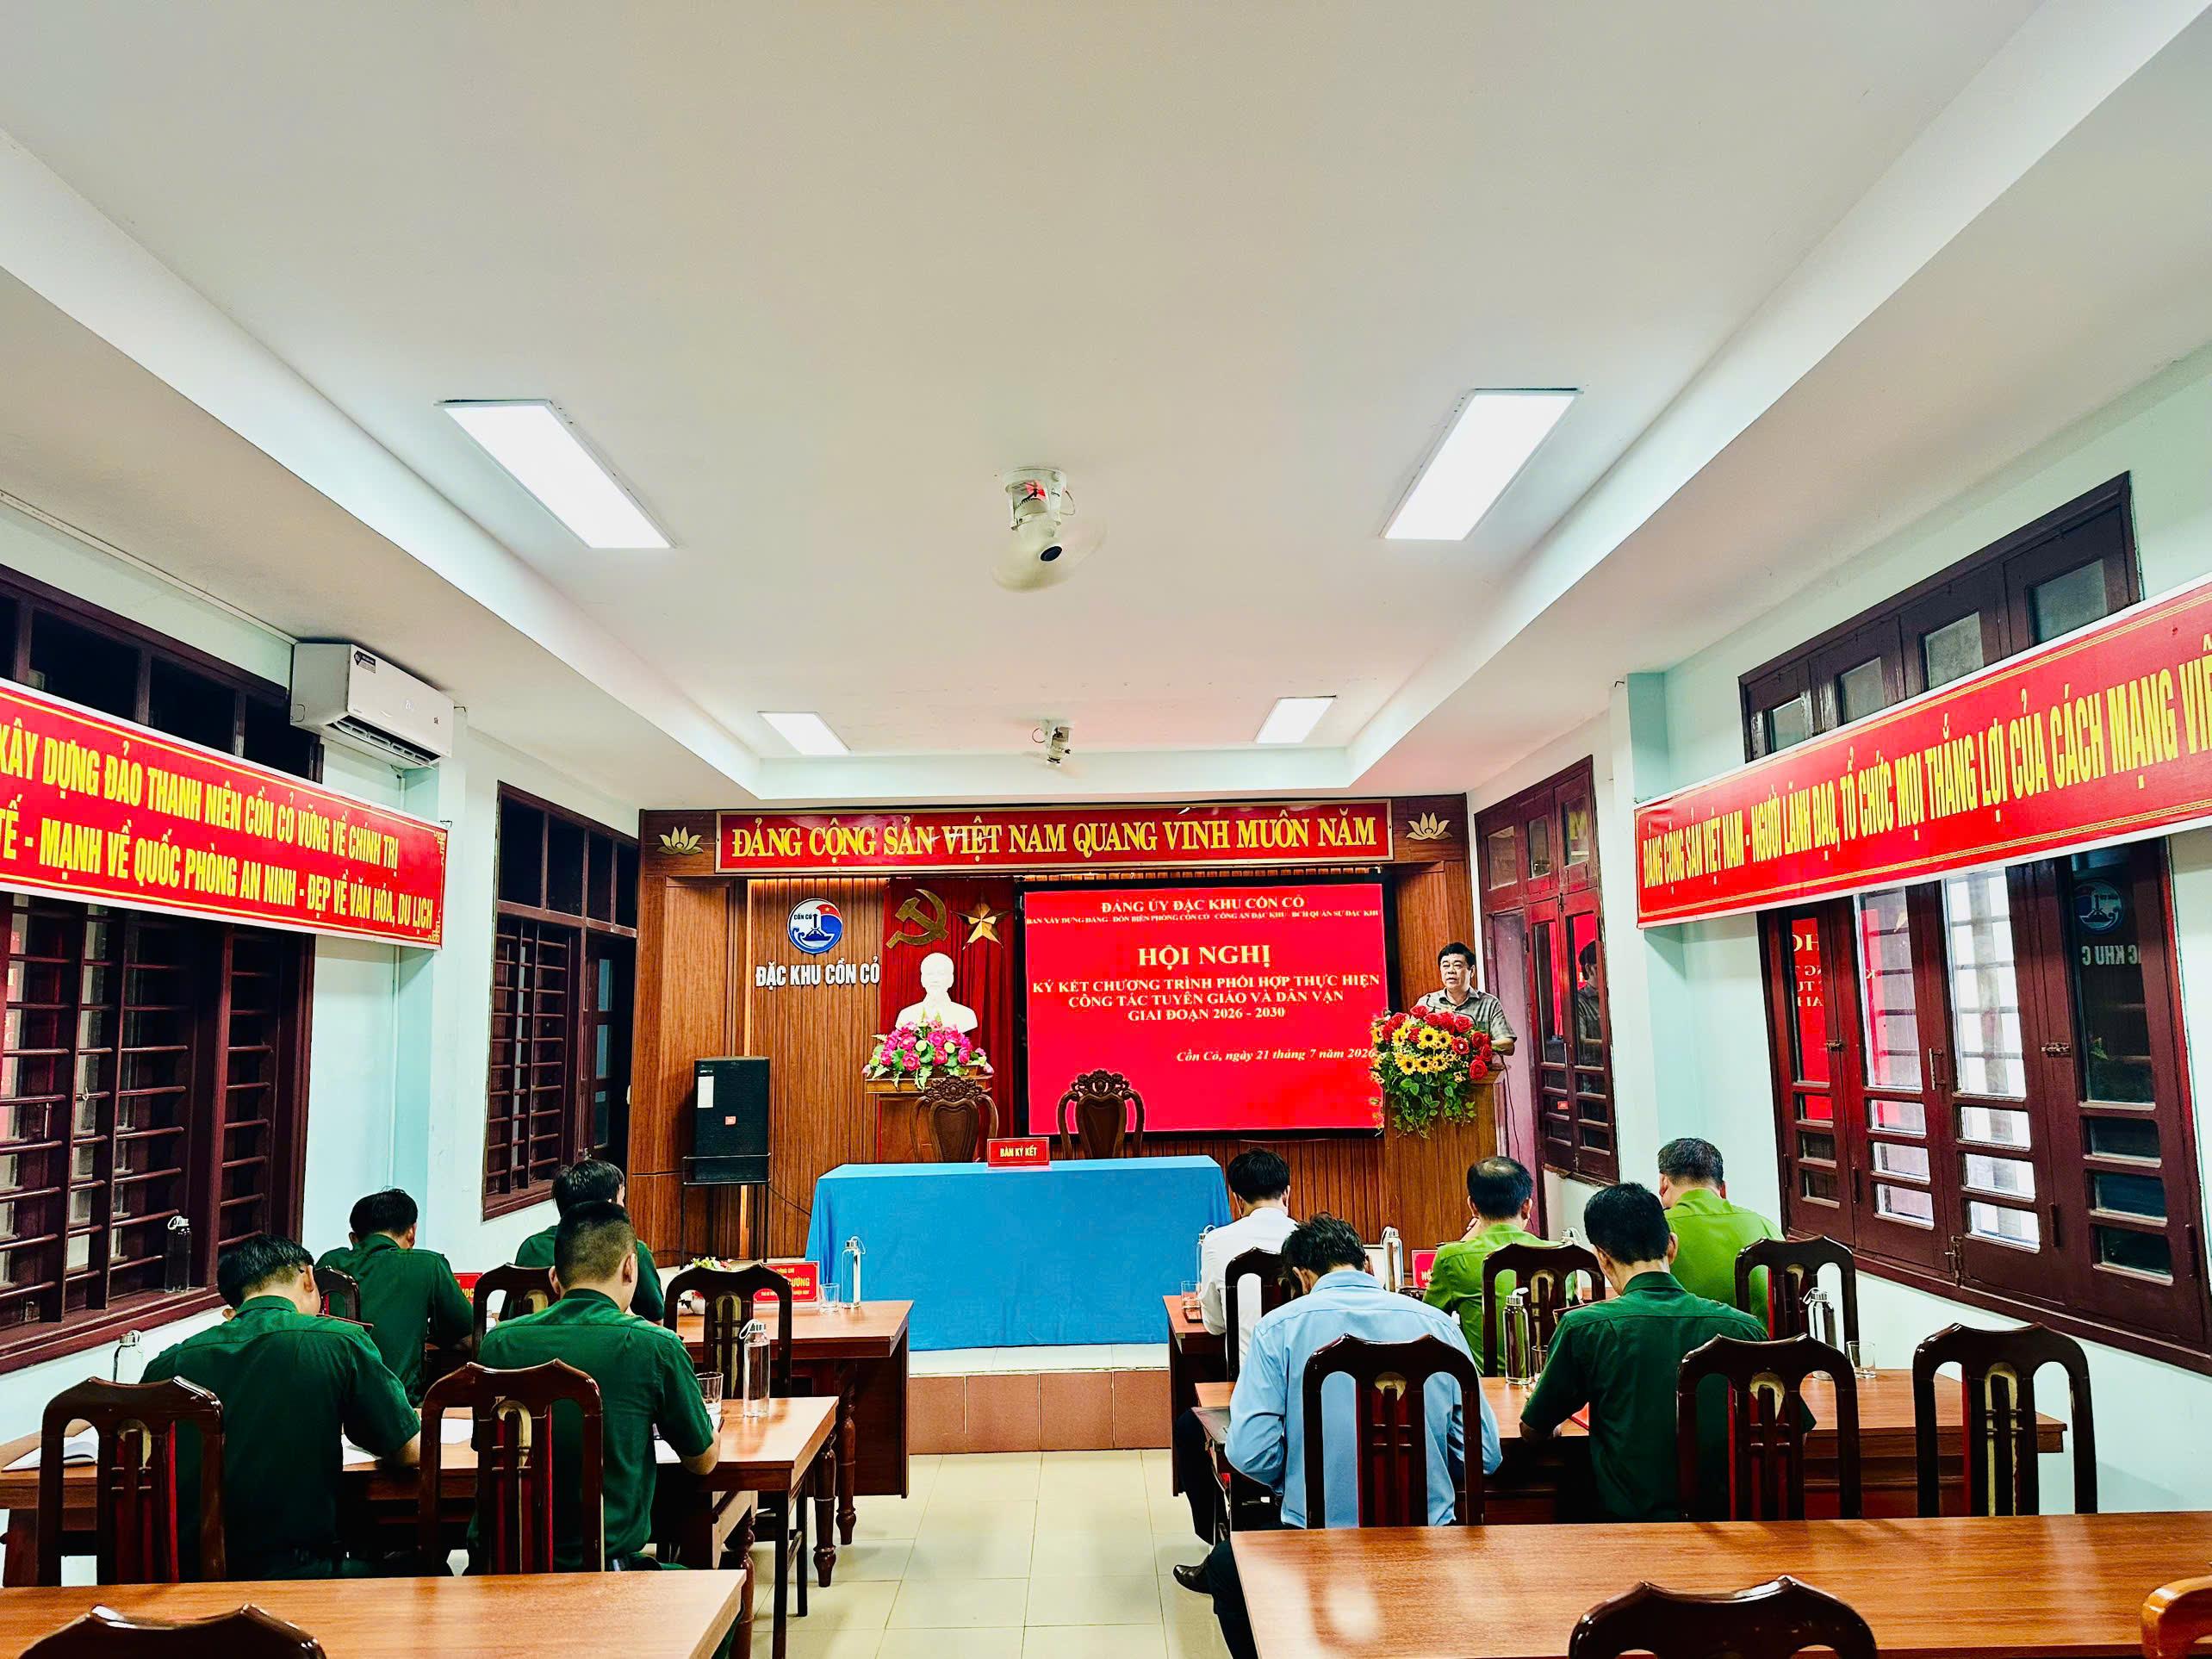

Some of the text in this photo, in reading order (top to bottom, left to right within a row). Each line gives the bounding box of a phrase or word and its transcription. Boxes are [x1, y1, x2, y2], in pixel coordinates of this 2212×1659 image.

[1643, 821, 1663, 888] ĐẢNG
[1664, 820, 1685, 895] CỘNG
[1686, 806, 1703, 879] SẢN
[1703, 806, 1722, 885] VIỆT
[1722, 810, 1744, 869] NAM
[1750, 784, 1782, 862] NGƯỜI
[1782, 780, 1812, 854] LÃNH
[1811, 780, 1841, 861] ĐẠO,
[1840, 746, 1857, 841] TỔ
[1858, 749, 1893, 837] CHỨC
[1895, 752, 1925, 841] MỌI
[1924, 712, 1978, 820] THẮNG
[1979, 718, 2008, 823] LỢI
[2009, 688, 2049, 800] CỦA
[2049, 683, 2106, 790] CÁCH
[2107, 668, 2179, 789] MẠNG
[43, 737, 100, 799] DỰNG
[104, 741, 142, 806] ĐẢO
[147, 767, 202, 821] THANH
[204, 780, 242, 831] NIÊN
[245, 786, 274, 839] CỒN
[276, 792, 295, 843] CỎ
[298, 805, 330, 854] VỮNG
[332, 811, 349, 857] VỀ
[349, 822, 382, 866] CHÍNH
[383, 835, 400, 877] TRỊ
[732, 817, 801, 857] ĐẢNG
[810, 817, 877, 863] CỘNG
[884, 816, 933, 855] SẢN
[941, 816, 1003, 862] VIỆT
[1009, 824, 1067, 853] NAM
[1072, 822, 1158, 858] QUANG
[1236, 810, 1309, 848] MUÔN
[1318, 808, 1376, 847] NĂM
[24, 836, 34, 848] -
[40, 817, 103, 880] MẠNH
[108, 819, 132, 879] VỀ
[134, 829, 181, 887] QUỐC
[183, 843, 238, 898] PHÒNG
[239, 861, 261, 901] AN
[264, 865, 297, 907] NINH
[307, 873, 331, 919] ĐẸP
[333, 868, 349, 916] VỀ
[350, 877, 371, 920] VĂN
[373, 882, 395, 928] HÓA,
[397, 893, 412, 926] DU
[413, 894, 433, 935] LỊCH
[1209, 898, 1241, 910] KHU
[1138, 944, 1271, 971] HỘI NGHỊ
[755, 955, 880, 991] ĐẶC KHU CỒN CỎ
[1033, 979, 1053, 992] KÝ
[1092, 979, 1160, 991] CHƯƠNG
[1164, 975, 1212, 990] TRÌNH
[1258, 976, 1290, 990] HỢP
[1294, 973, 1338, 989] THỰC
[1068, 993, 1113, 1008] CÔNG
[1115, 992, 1148, 1006] TÁC
[1152, 991, 1203, 1005] TUYÊN
[1207, 990, 1246, 1004] GIÁO
[1251, 989, 1271, 1003] VÀ
[1276, 988, 1308, 1002] DÂN
[1128, 1010, 1161, 1021] GIAI
[1165, 1009, 1209, 1022] ĐOẠN
[1213, 1008, 1243, 1019] 2026
[1255, 1007, 1285, 1018] 2030
[1177, 1048, 1199, 1061] Cồn
[1226, 1051, 1253, 1062] ngày
[1256, 1050, 1269, 1060] 21
[1272, 1048, 1305, 1060] tháng
[1309, 1048, 1316, 1058] 7
[1319, 1048, 1344, 1059] năm
[1000, 1145, 1037, 1157] BÀN KÝ KẾT
